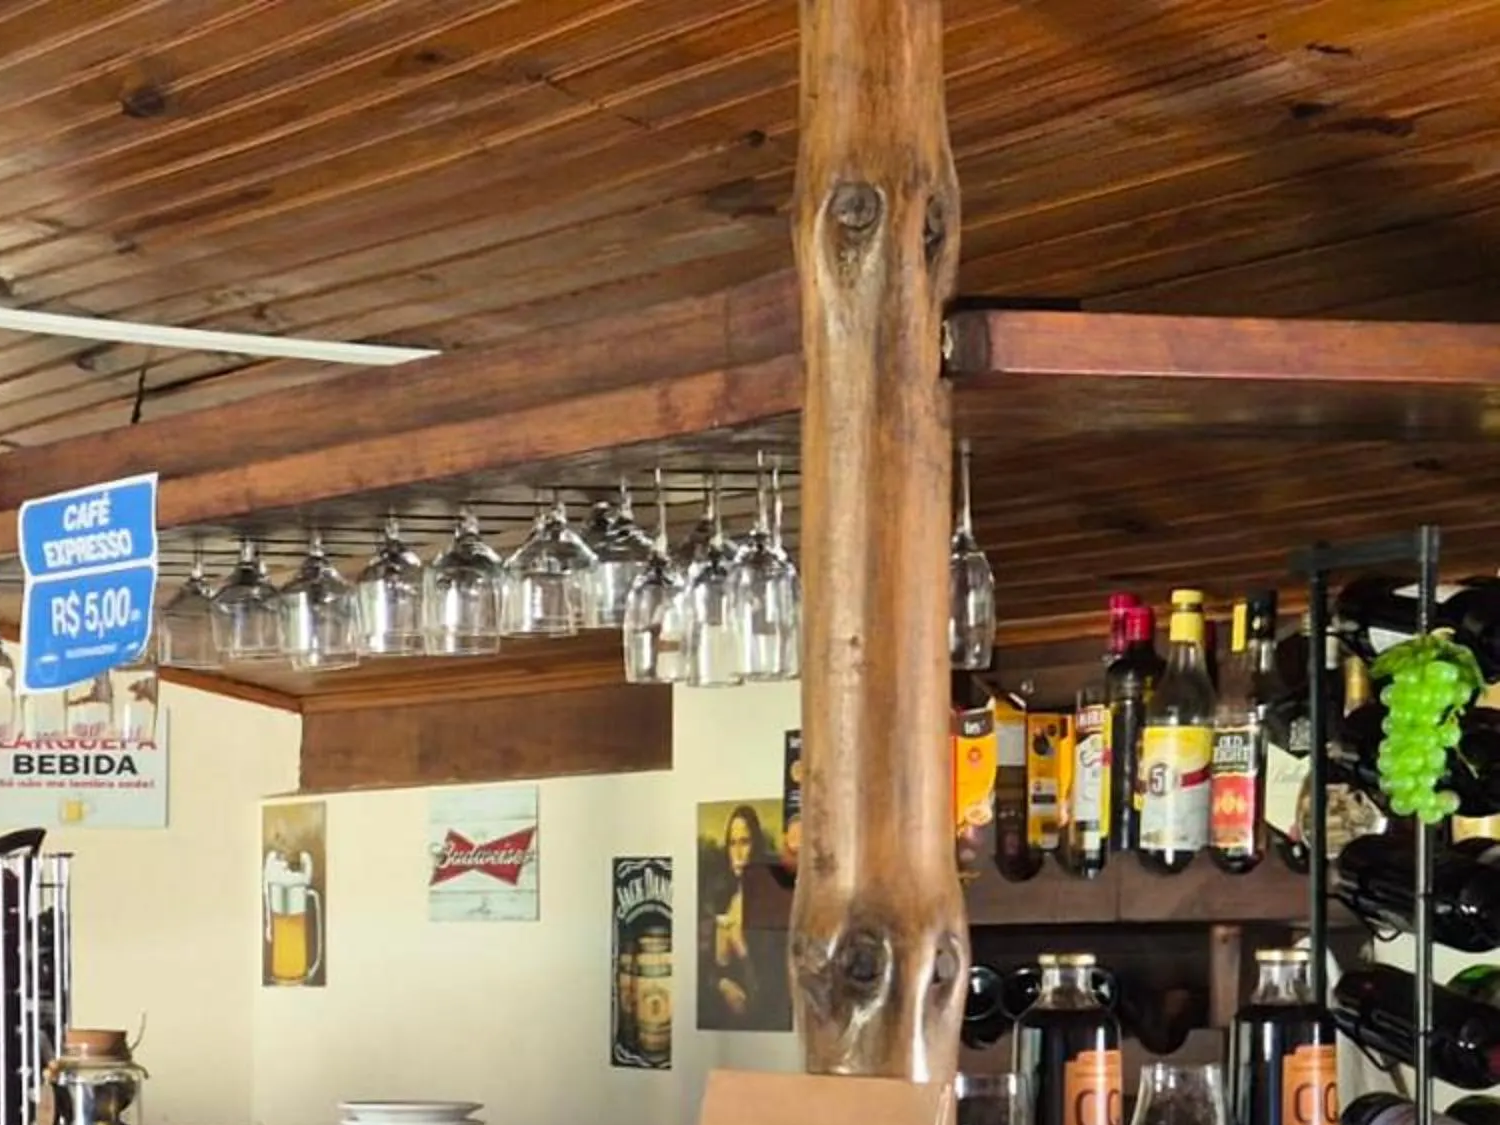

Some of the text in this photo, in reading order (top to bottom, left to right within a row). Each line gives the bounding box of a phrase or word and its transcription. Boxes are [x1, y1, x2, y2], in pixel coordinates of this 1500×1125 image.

[63, 492, 110, 530] CAFÉ
[43, 529, 132, 567] EXPRESSO
[51, 586, 131, 640] R$ 5,00
[12, 753, 138, 775] BEBIDA
